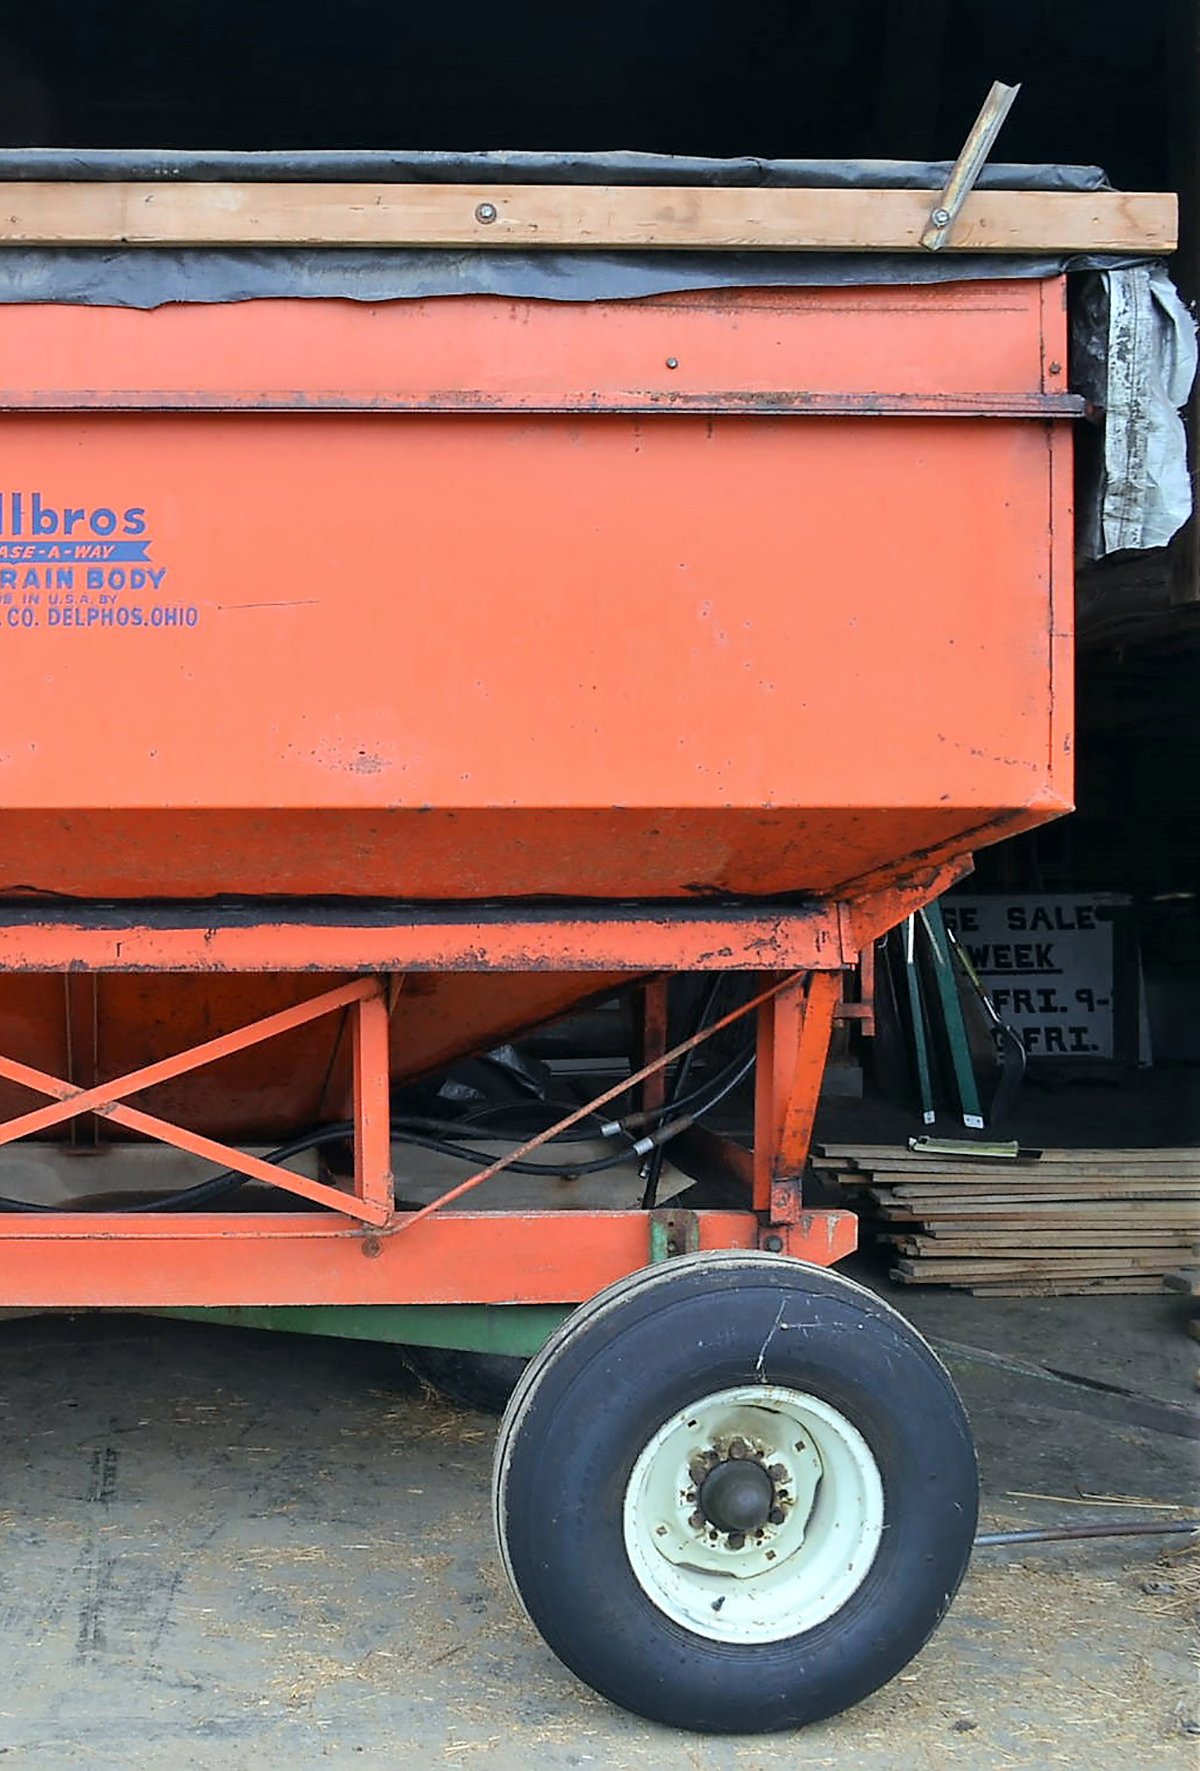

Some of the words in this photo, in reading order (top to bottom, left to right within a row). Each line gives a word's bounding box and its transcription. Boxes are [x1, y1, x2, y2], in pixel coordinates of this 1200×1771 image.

[86, 567, 166, 590] BODY
[22, 594, 39, 604] IN
[48, 594, 93, 604] U.S.A.
[99, 594, 117, 604] BY
[7, 608, 39, 627] CO.
[1007, 906, 1096, 930] SALE
[965, 944, 1054, 968] WEEK
[992, 988, 1068, 1013] FRI.
[1022, 1026, 1099, 1052] FRI.
